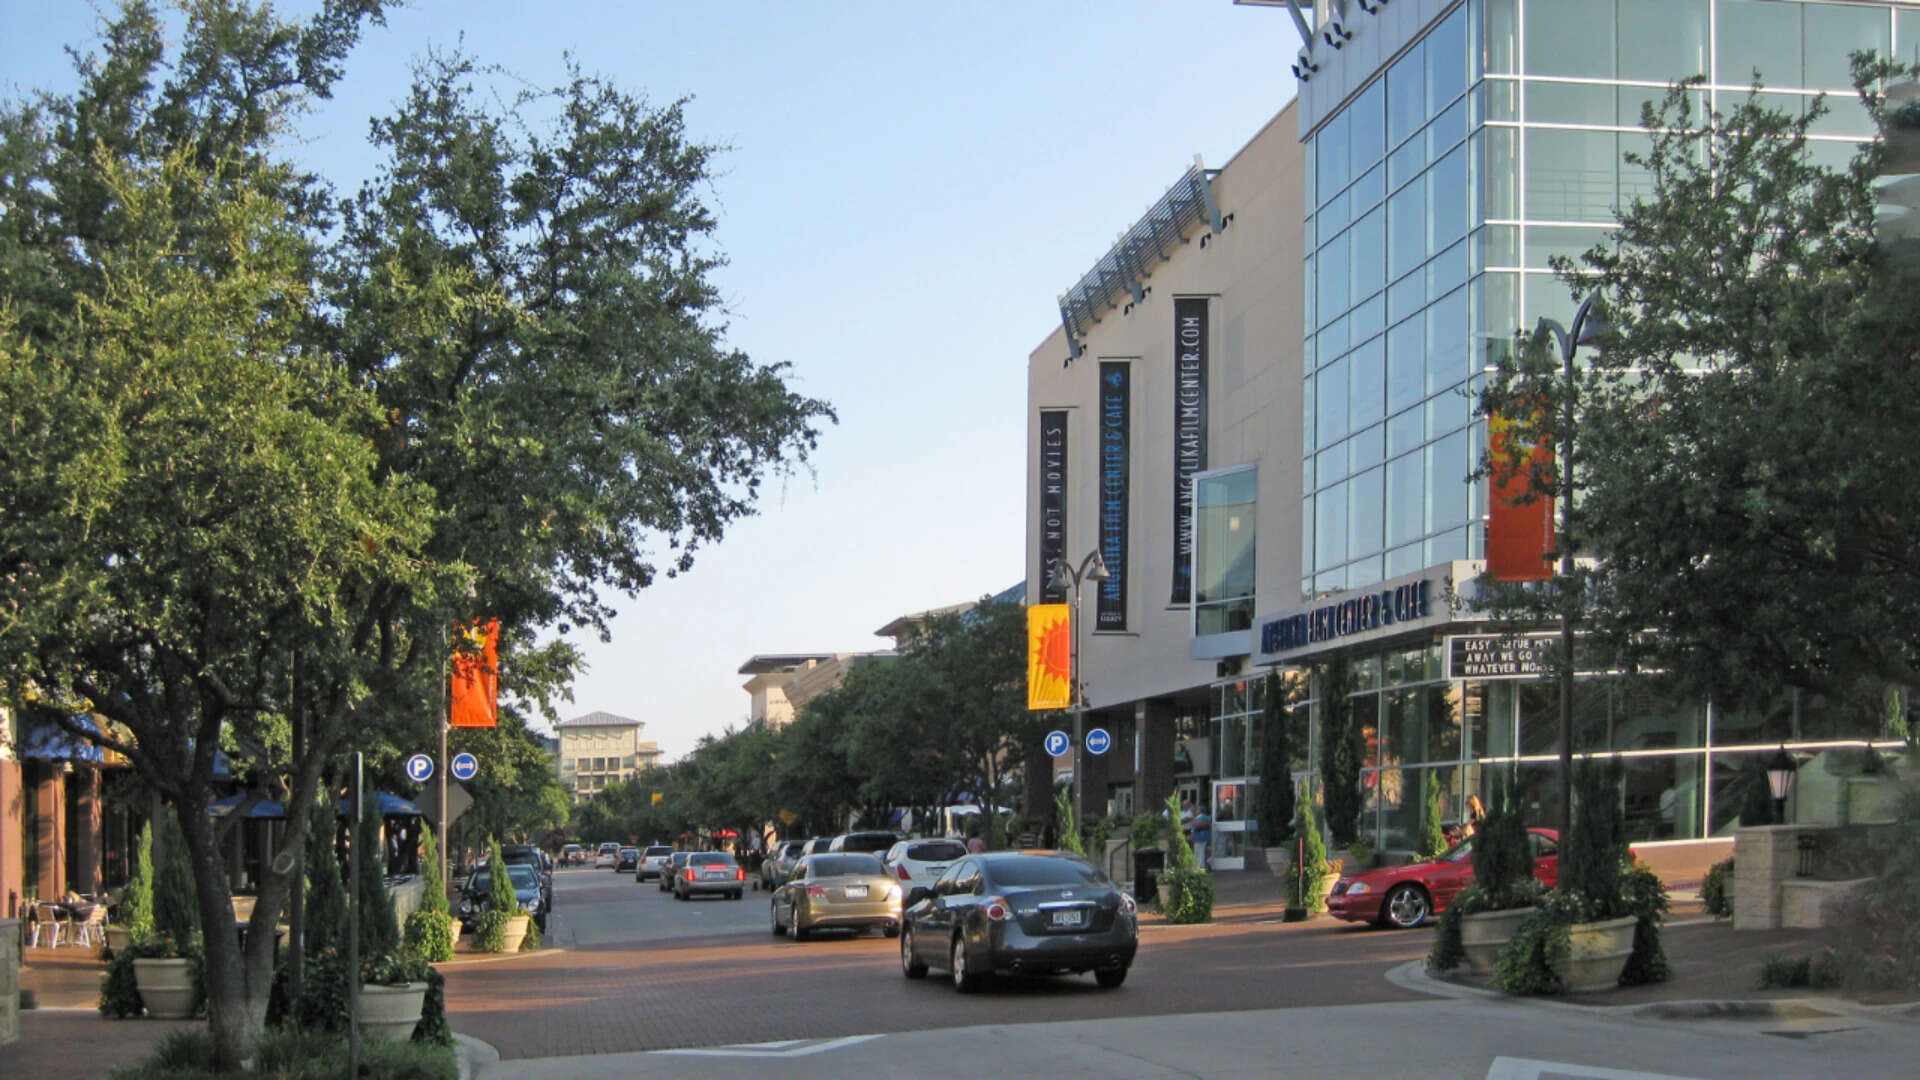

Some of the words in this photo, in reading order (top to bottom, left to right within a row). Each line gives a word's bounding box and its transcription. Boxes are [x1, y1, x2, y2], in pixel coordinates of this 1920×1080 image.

[1104, 431, 1123, 440] &
[1180, 317, 1200, 555] WWWANGELIKAFILMCENTER.COM
[1046, 428, 1062, 494] MOVIES
[1104, 444, 1123, 496] CENTER
[1047, 507, 1061, 539] NOT
[1104, 500, 1121, 532] FILM
[1464, 640, 1491, 651] EASY
[1466, 652, 1495, 663] AWAY
[1519, 650, 1532, 660] GO
[1464, 663, 1516, 674] WHATEVER
[1051, 736, 1063, 752] P
[414, 759, 427, 776] P
